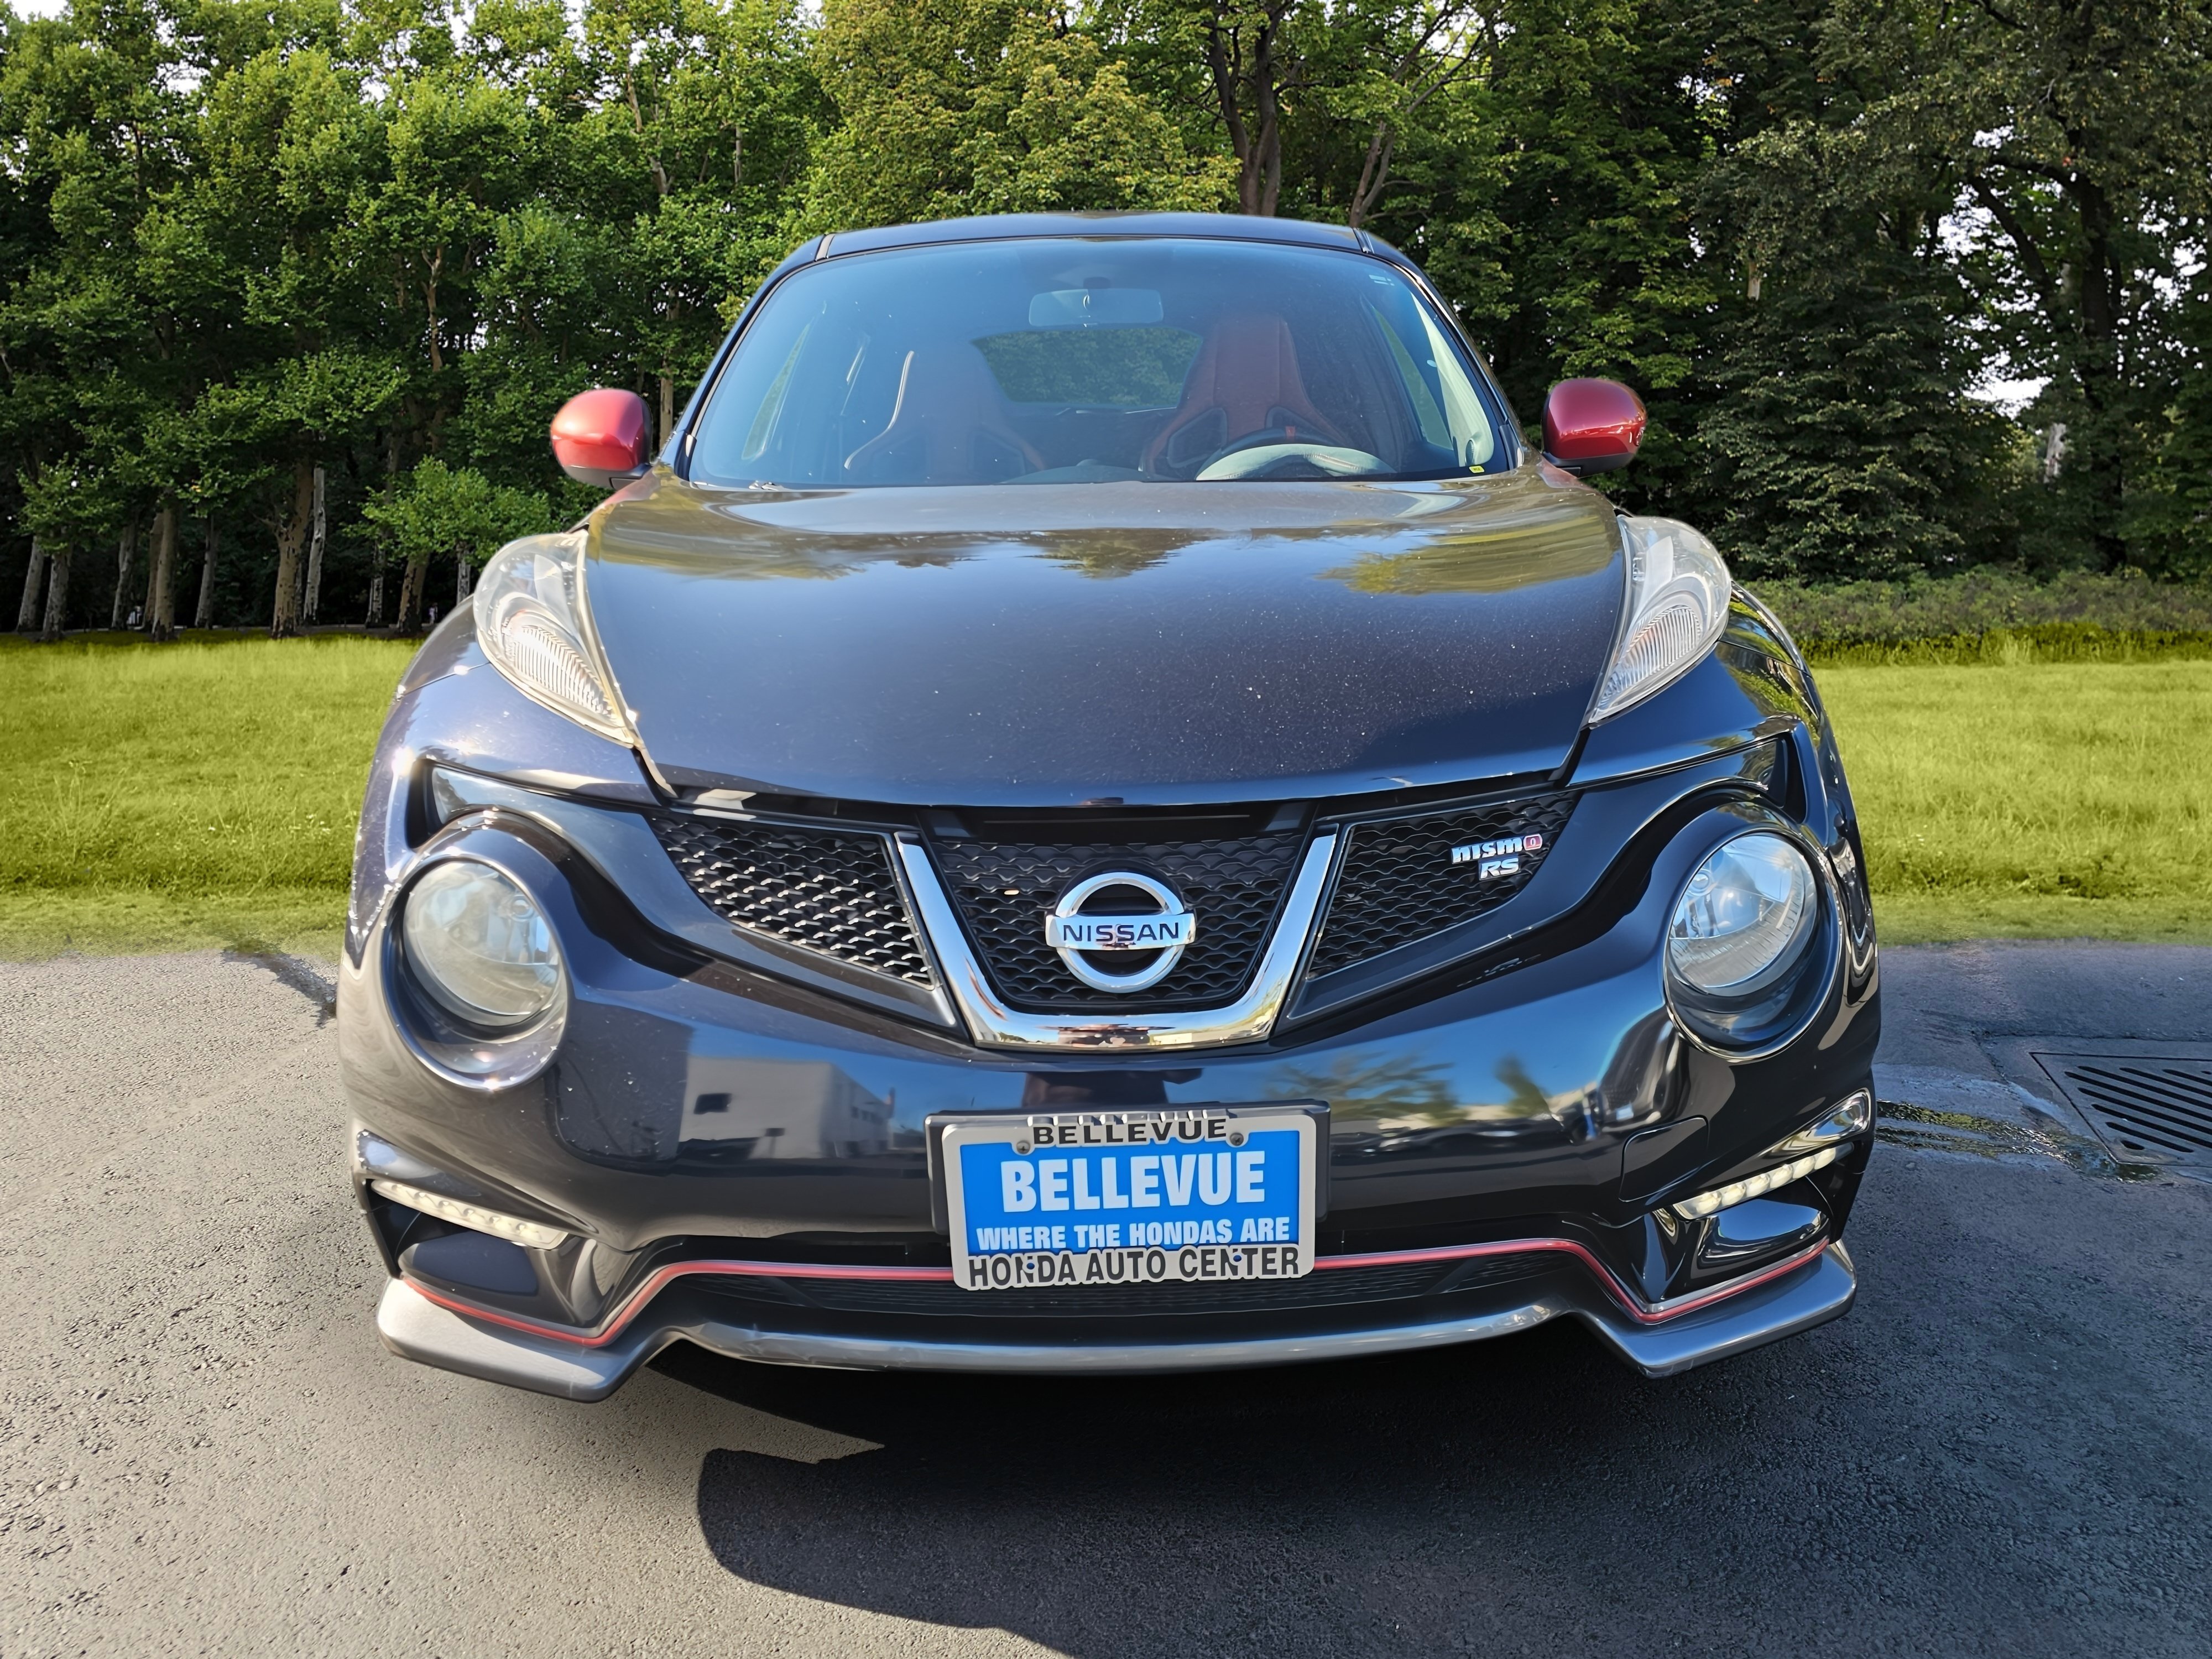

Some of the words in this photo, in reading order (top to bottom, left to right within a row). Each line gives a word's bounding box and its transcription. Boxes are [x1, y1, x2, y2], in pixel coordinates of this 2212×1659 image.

[1480, 857, 1519, 879] RS
[1063, 922, 1179, 942] NISSAN
[1033, 1118, 1227, 1145] BELLEVUE
[1001, 1151, 1265, 1213] BELLEVUE
[976, 1225, 1067, 1251] WHERE
[1073, 1223, 1120, 1248] THE
[1129, 1218, 1233, 1246] HONDAS
[1240, 1217, 1290, 1242] ARE
[968, 1252, 1077, 1287] HONDA
[1086, 1250, 1166, 1281] AUTO
[1179, 1246, 1300, 1278] CENTER
